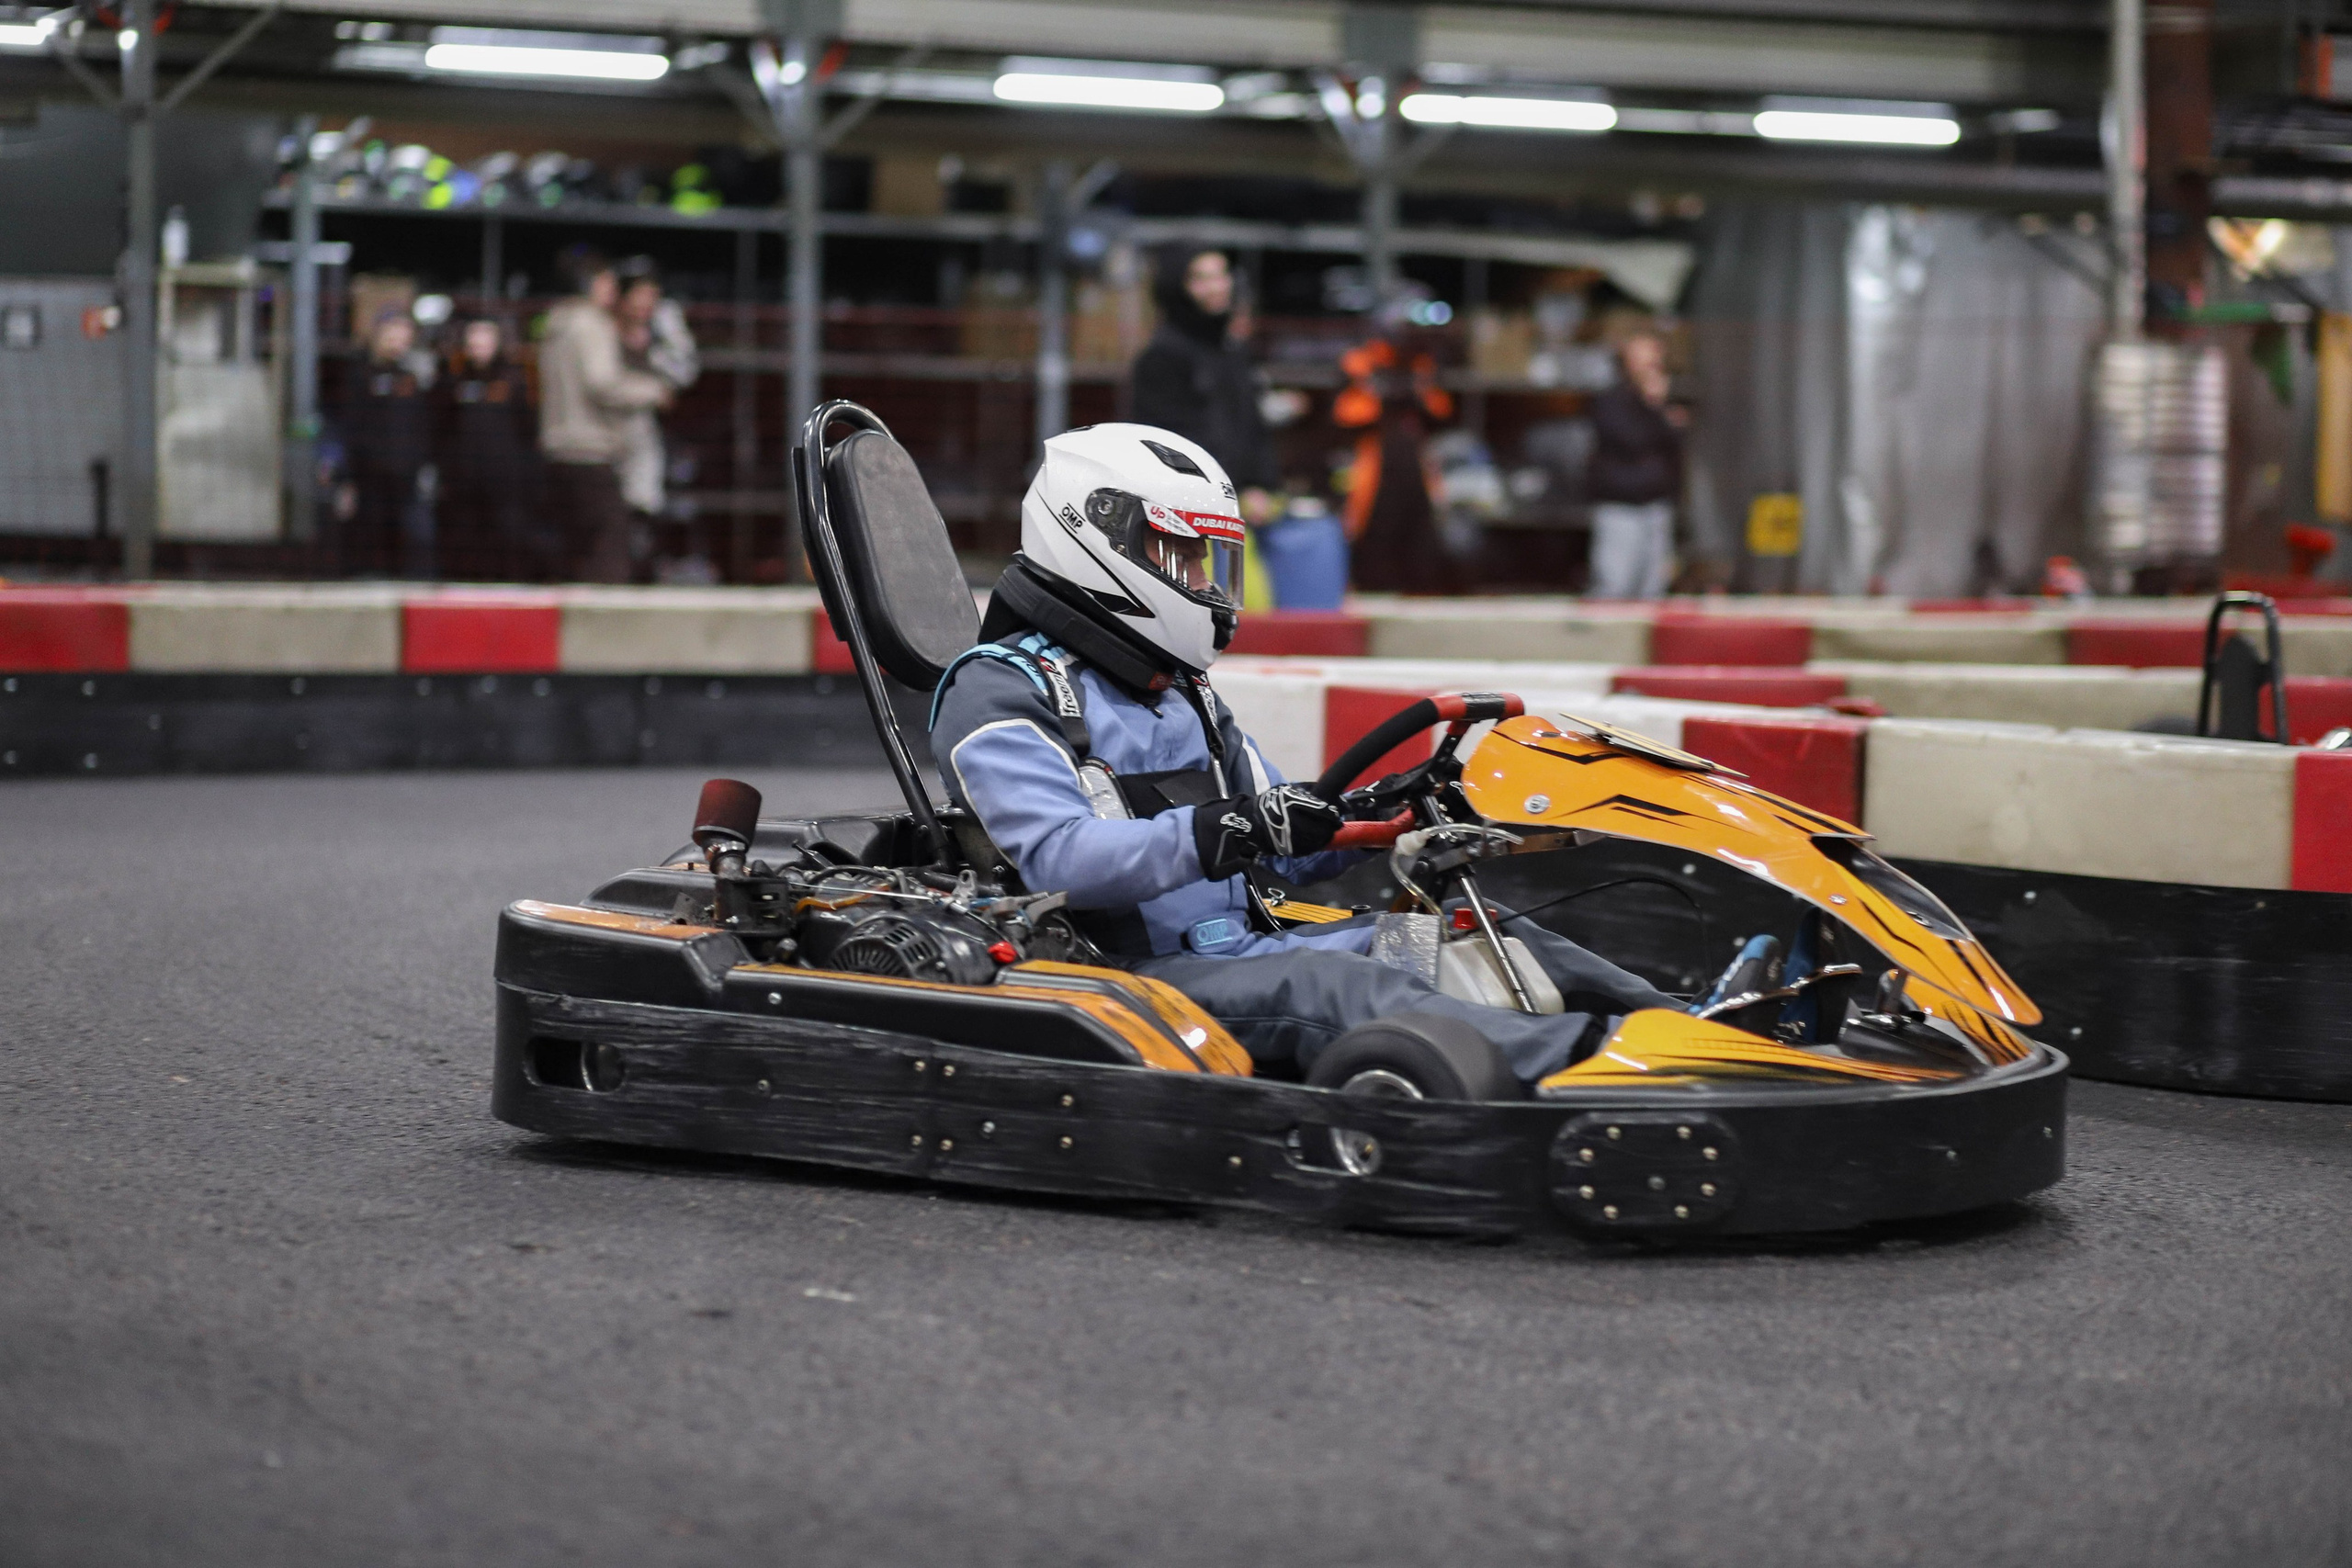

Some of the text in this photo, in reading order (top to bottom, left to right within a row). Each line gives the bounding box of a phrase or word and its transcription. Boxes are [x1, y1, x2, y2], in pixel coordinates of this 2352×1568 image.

[1062, 506, 1083, 528] OMP
[1193, 517, 1227, 530] DUBAI
[1196, 922, 1227, 942] OMP
